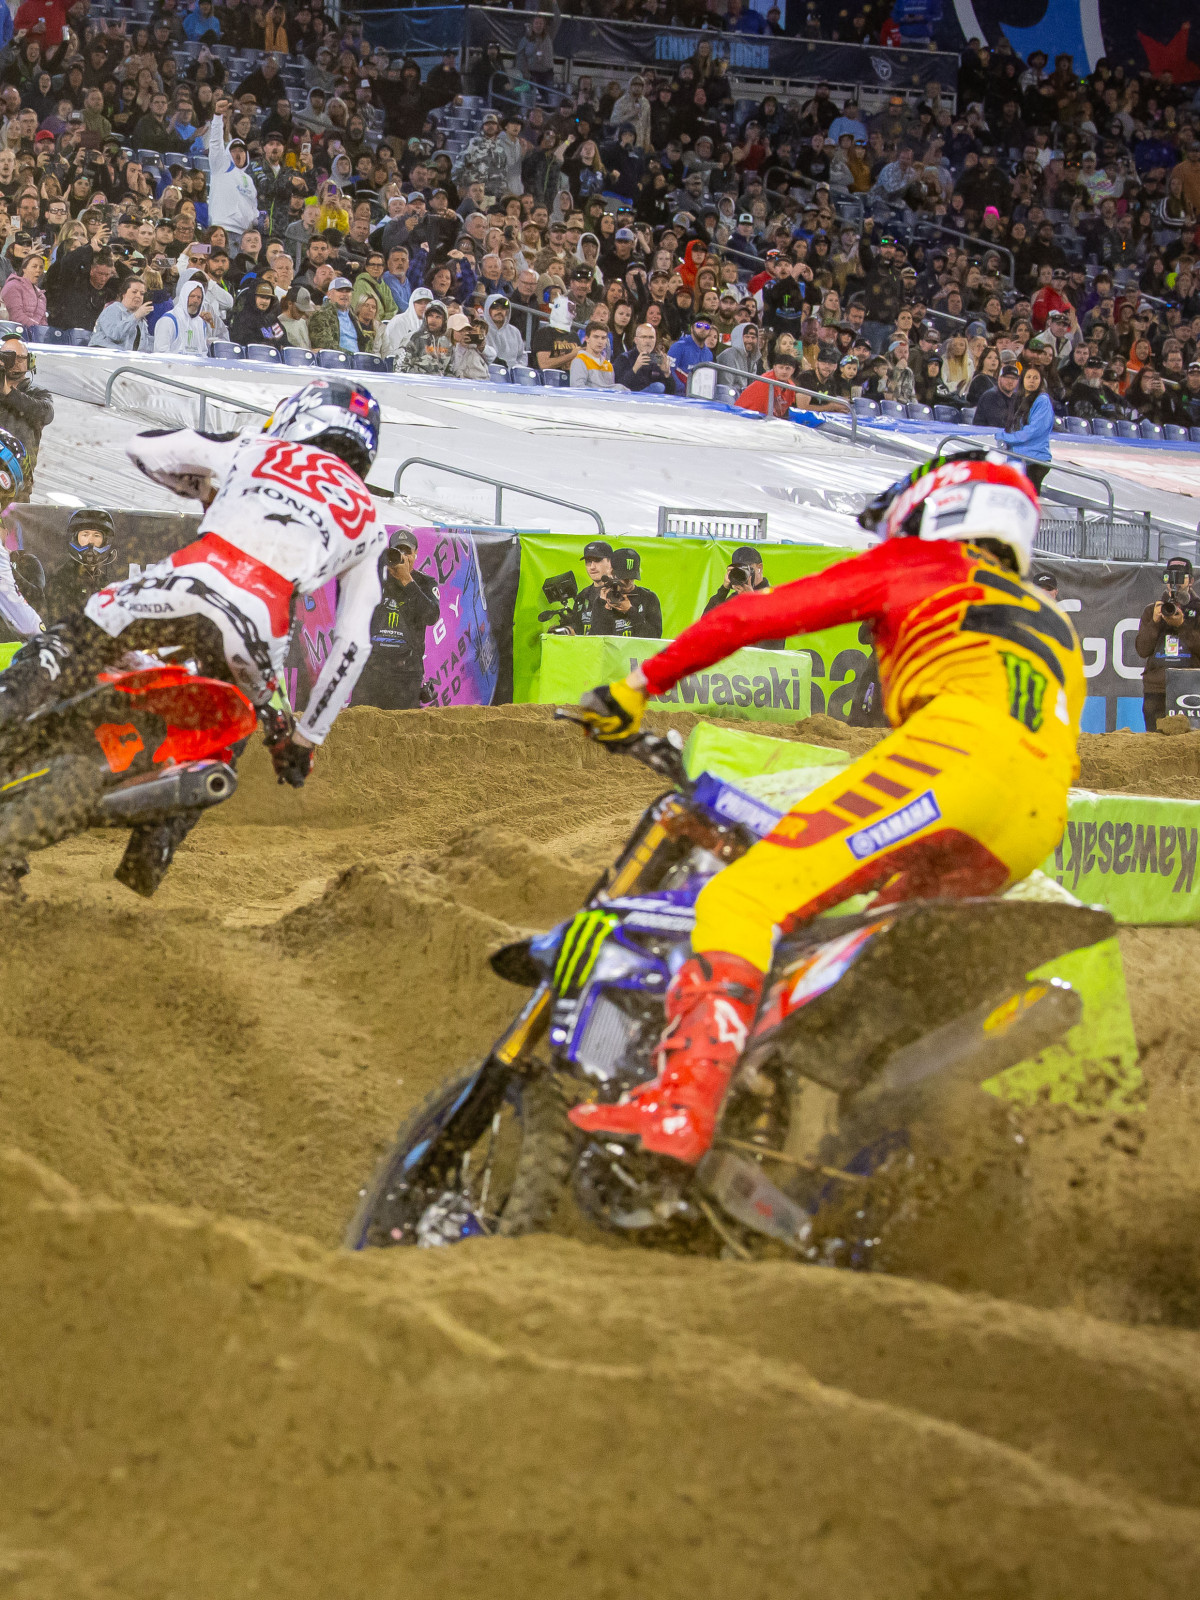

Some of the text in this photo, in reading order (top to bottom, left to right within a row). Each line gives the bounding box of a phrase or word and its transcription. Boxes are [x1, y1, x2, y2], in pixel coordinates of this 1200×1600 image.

[0, 473, 10, 487] BELL
[242, 485, 331, 549] HONDA
[128, 601, 174, 615] HONDA
[379, 629, 404, 637] MONSTER
[868, 796, 938, 847] YAMAHA
[1054, 820, 1198, 894] Kawasaki
